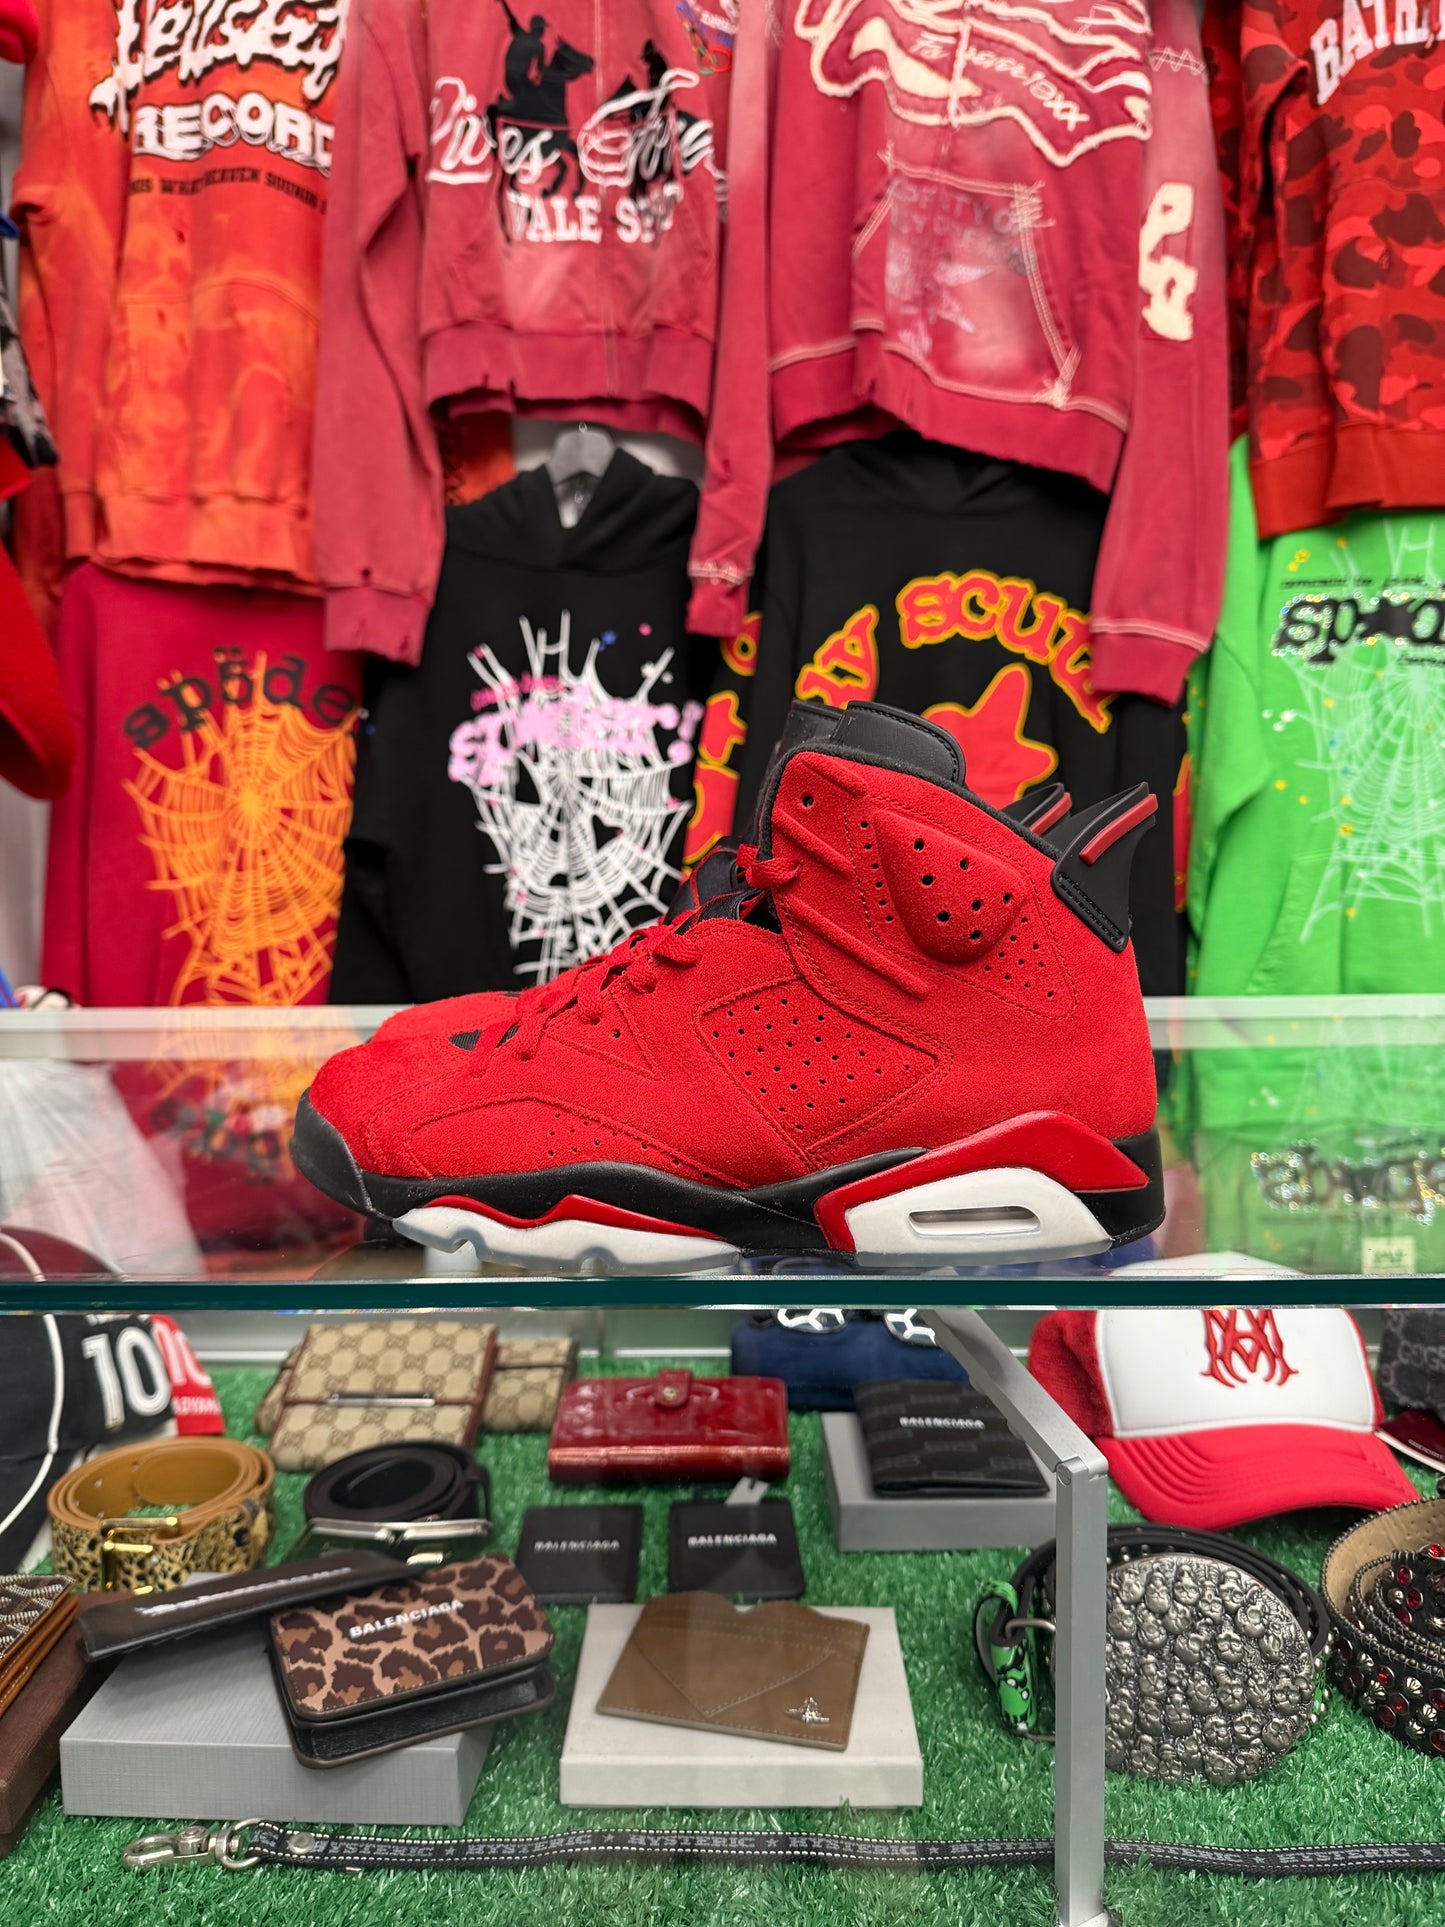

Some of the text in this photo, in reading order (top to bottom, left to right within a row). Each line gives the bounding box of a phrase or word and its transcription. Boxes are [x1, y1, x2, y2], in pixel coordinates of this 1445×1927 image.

[506, 189, 602, 243] VALE
[82, 1327, 170, 1432] 10
[350, 1599, 464, 1639] BALENCIAGA
[464, 1834, 592, 1857] HYSTERIC
[628, 1835, 755, 1849] HYSTERIC
[789, 1836, 917, 1855] HYSTERIC
[951, 1841, 1055, 1854] HYSTER
[1276, 1847, 1410, 1863] HYSTERIC
